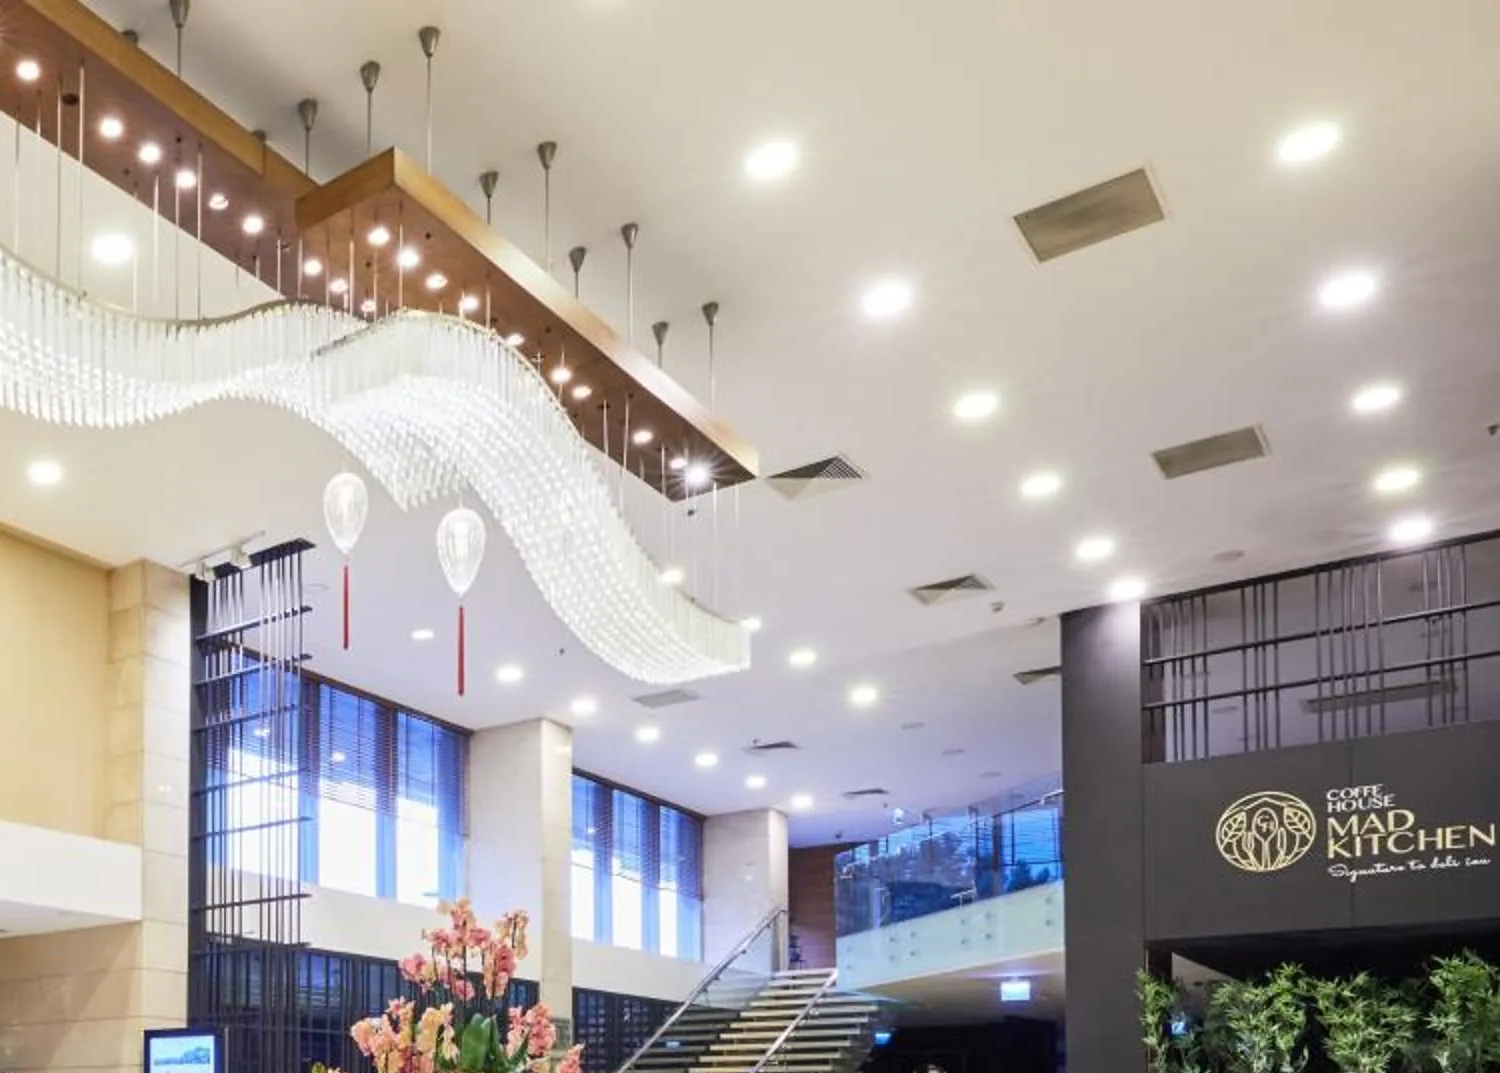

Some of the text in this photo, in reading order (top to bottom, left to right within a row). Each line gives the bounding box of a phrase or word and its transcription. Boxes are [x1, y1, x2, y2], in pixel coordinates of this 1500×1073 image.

[1327, 794, 1397, 813] HOUSE
[1327, 809, 1415, 838] MAD
[1327, 824, 1496, 859] KITCHEN
